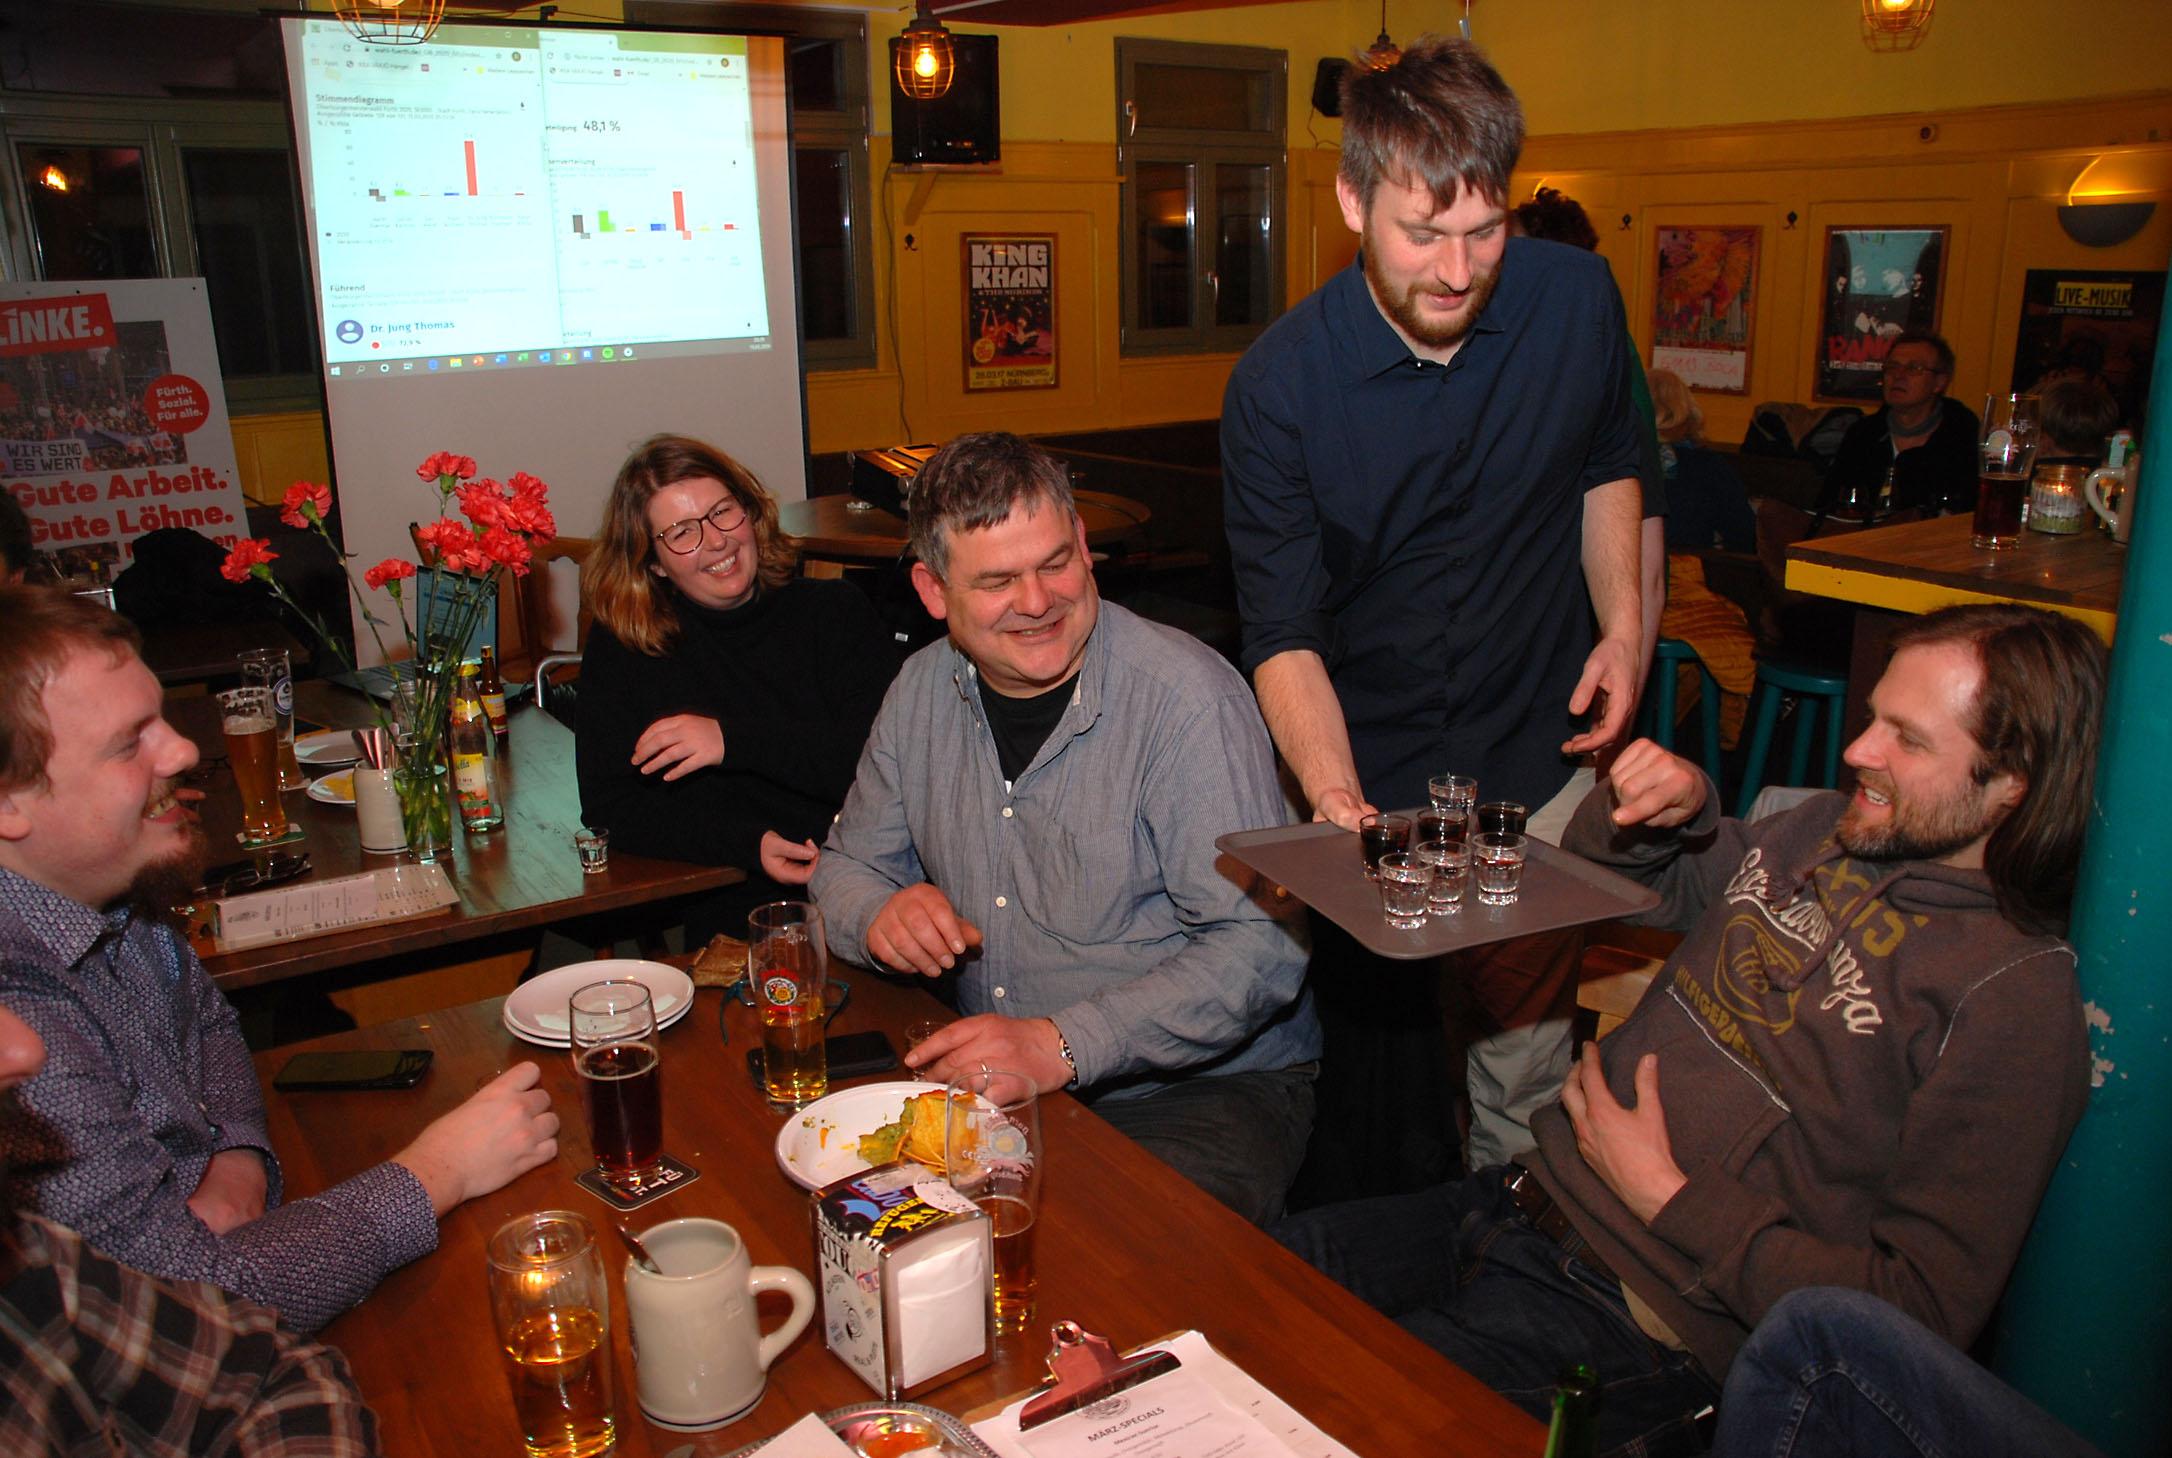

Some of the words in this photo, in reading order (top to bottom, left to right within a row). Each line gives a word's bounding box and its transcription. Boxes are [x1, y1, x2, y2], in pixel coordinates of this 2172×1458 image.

[315, 93, 394, 106] Stimmendiagramm
[583, 120, 607, 134] 48,1
[609, 120, 621, 132] %
[971, 244, 1048, 266] KING
[972, 267, 1048, 288] KHAN
[329, 283, 366, 293] Führend
[371, 324, 384, 334] Dr.
[388, 322, 411, 334] Jung
[414, 320, 455, 331] Thomas
[156, 385, 192, 397] Fürth.
[158, 395, 197, 409] Sozial.
[156, 409, 177, 421] Für
[179, 407, 204, 418] alle.
[8, 442, 43, 458] WIR
[47, 442, 82, 458] SIND
[13, 457, 38, 472] ES
[42, 456, 82, 472] WERT
[8, 480, 98, 508] Gute
[107, 466, 228, 500] Arbeit.
[32, 514, 110, 544] Gute
[117, 504, 234, 534] Löhne.
